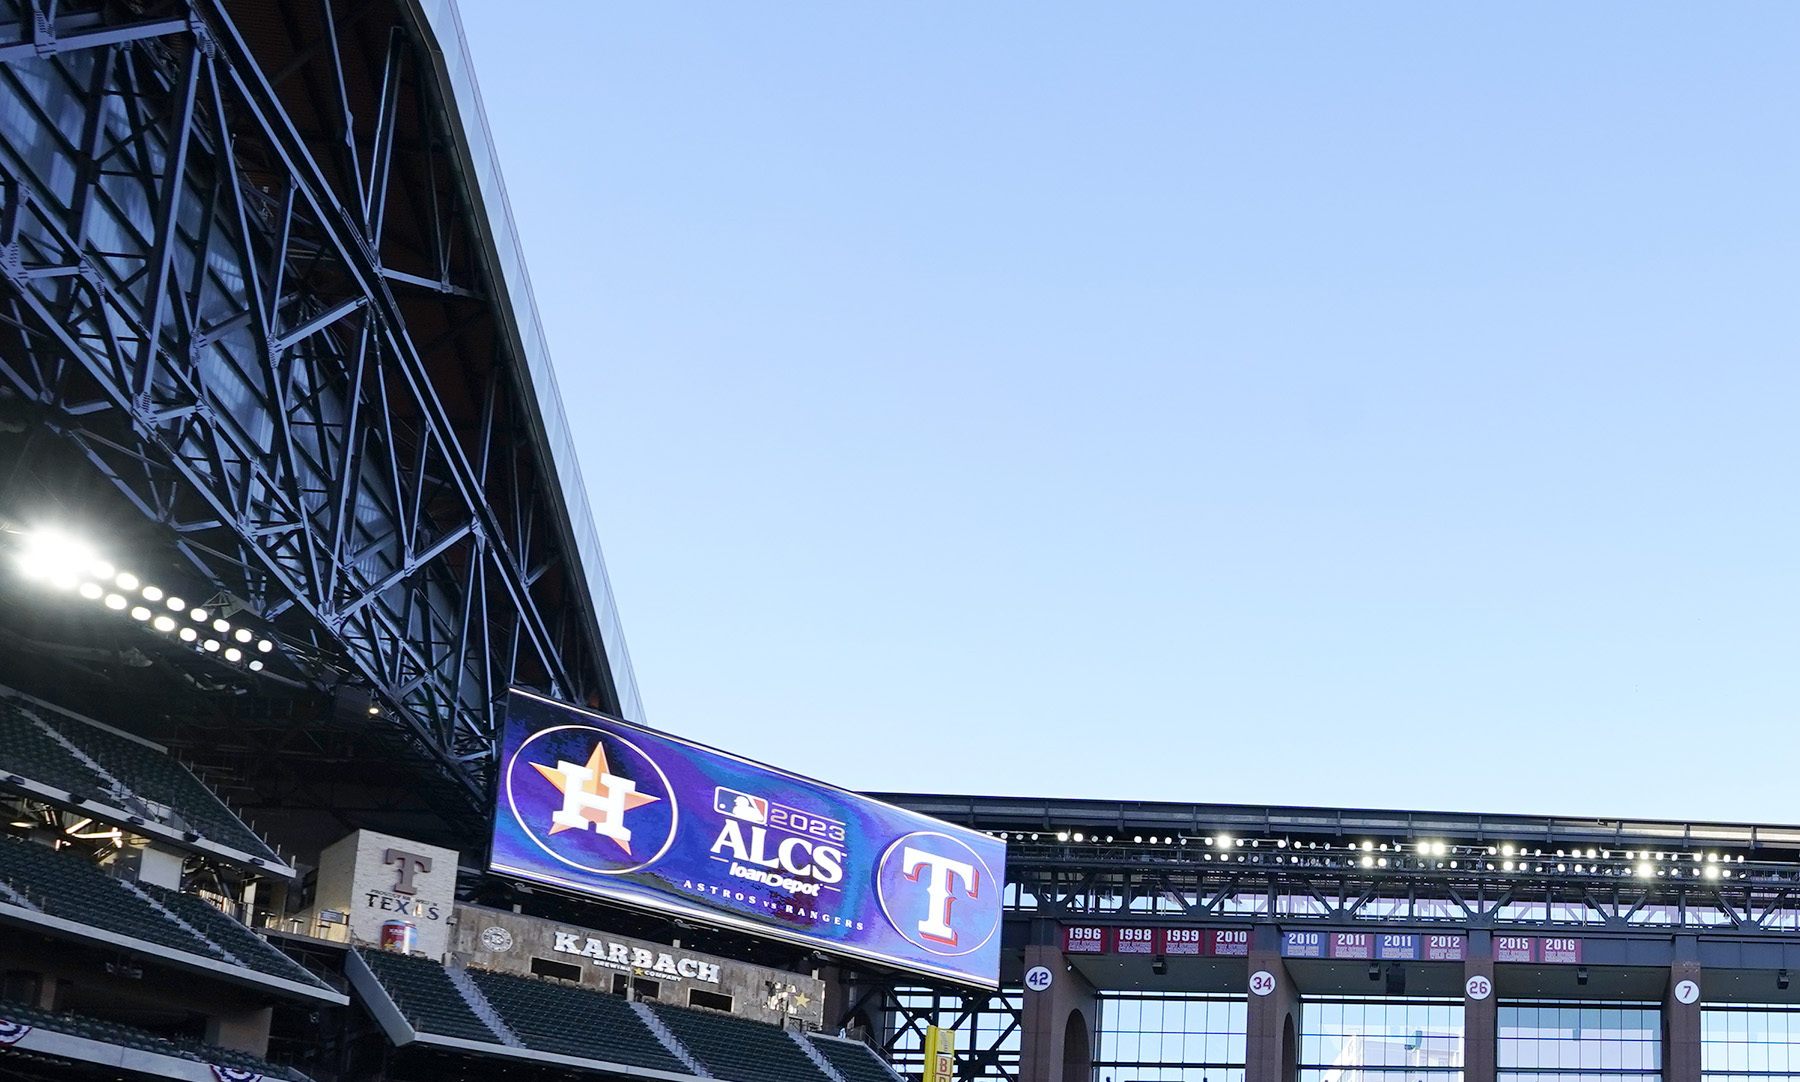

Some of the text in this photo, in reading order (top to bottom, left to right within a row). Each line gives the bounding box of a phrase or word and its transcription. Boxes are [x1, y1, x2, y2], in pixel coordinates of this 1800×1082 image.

[552, 759, 636, 842] H
[770, 808, 846, 842] 2023
[710, 818, 843, 883] ALCS
[729, 862, 822, 897] loanDepot
[365, 893, 440, 921] TEXAS
[684, 880, 757, 904] ASTROS
[785, 905, 864, 930] RANGERS
[1069, 927, 1101, 940] 1996
[1119, 928, 1152, 941] 1998
[1166, 929, 1199, 942] 1999
[1216, 930, 1247, 943] 2010
[1288, 932, 1319, 945] 2010
[1337, 933, 1366, 946] 2011
[1384, 935, 1412, 948] 2011
[1430, 936, 1460, 948] 2012
[1499, 937, 1529, 950] 2015
[1545, 938, 1575, 951] 2016
[554, 932, 720, 984] KARBACH
[593, 960, 682, 983] BREWING COMPANY
[1028, 969, 1050, 987] 42
[1253, 976, 1272, 990] 34
[1469, 981, 1488, 995] 26
[1682, 985, 1692, 1000] 7
